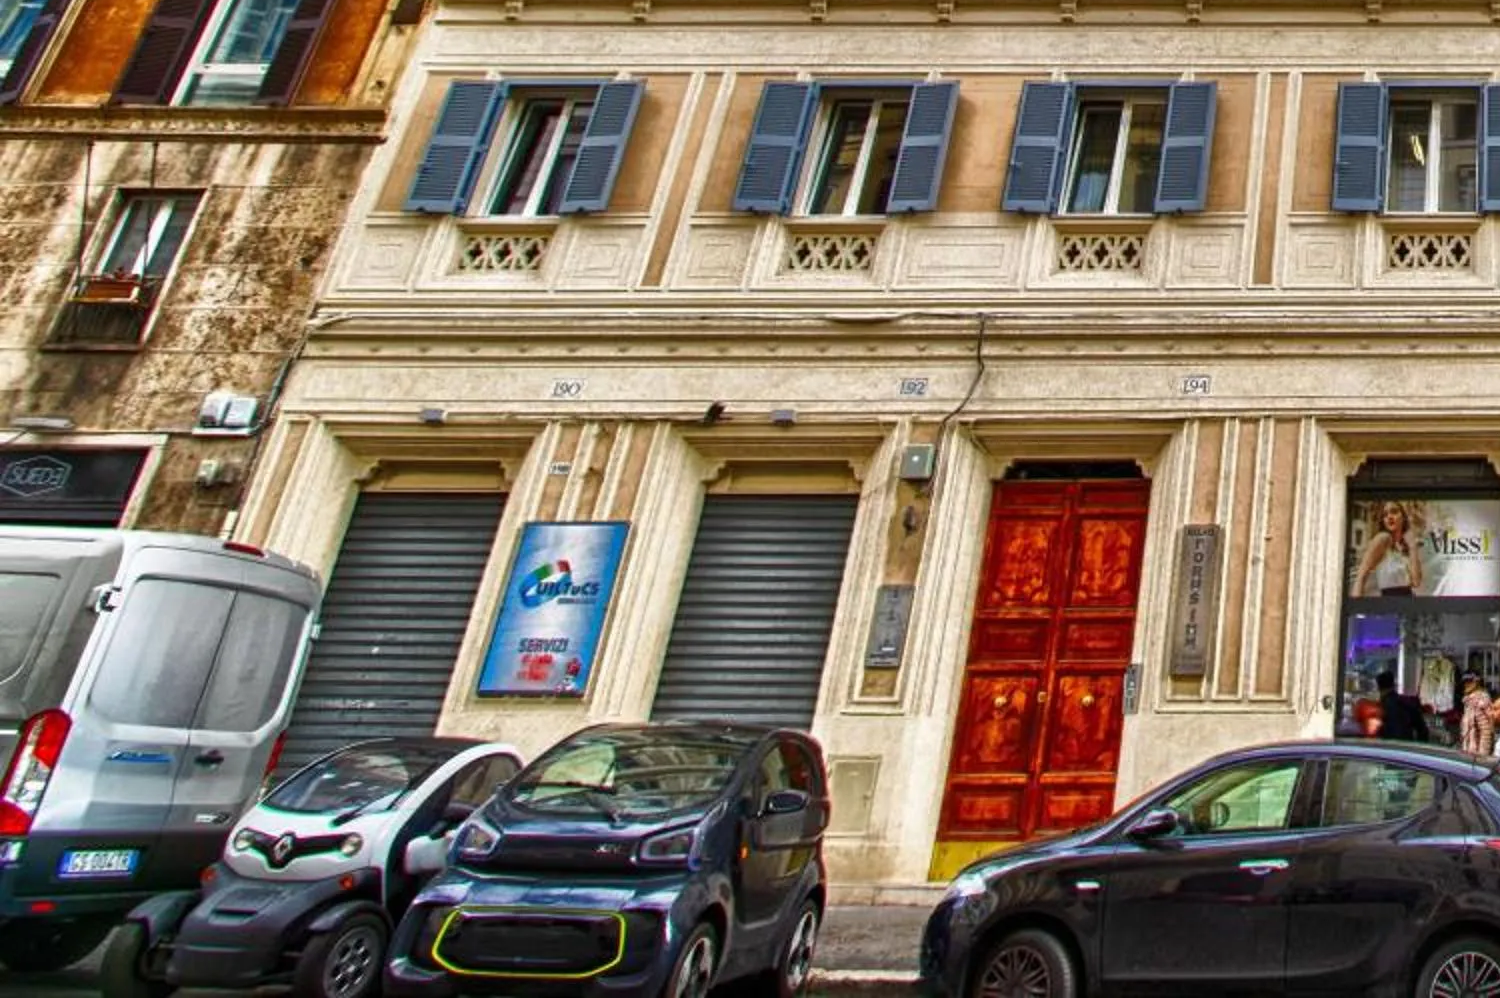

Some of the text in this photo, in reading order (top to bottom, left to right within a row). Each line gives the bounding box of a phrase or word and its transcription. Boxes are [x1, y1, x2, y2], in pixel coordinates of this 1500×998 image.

[552, 381, 581, 397] 190
[899, 378, 925, 395] 192
[1183, 379, 1207, 394] 194
[518, 638, 570, 652] SERVIZI
